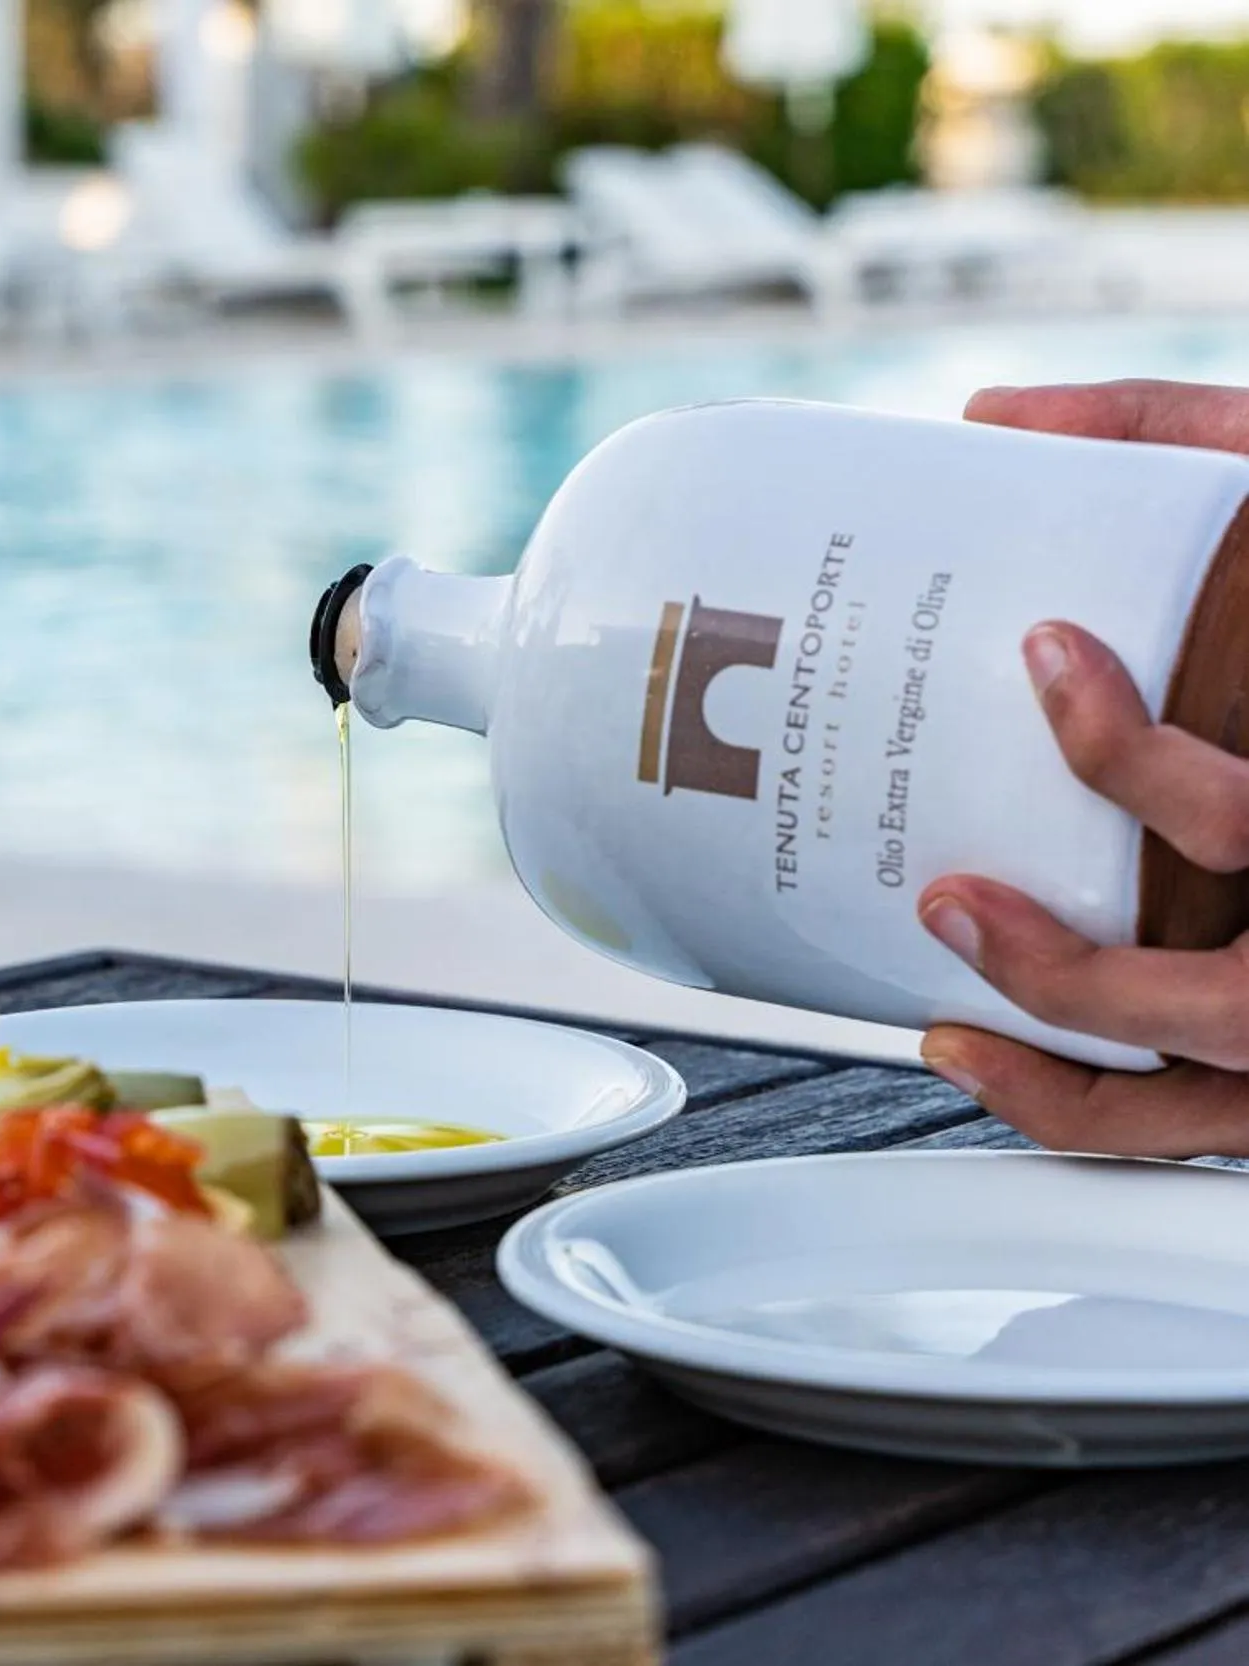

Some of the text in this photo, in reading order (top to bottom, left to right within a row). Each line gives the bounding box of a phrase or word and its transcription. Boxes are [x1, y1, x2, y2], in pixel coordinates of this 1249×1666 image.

[776, 531, 855, 893] TENUTA CENTOPORTE
[816, 723, 841, 840] resort
[876, 570, 953, 888] Olio Extra Vergine di Oliva
